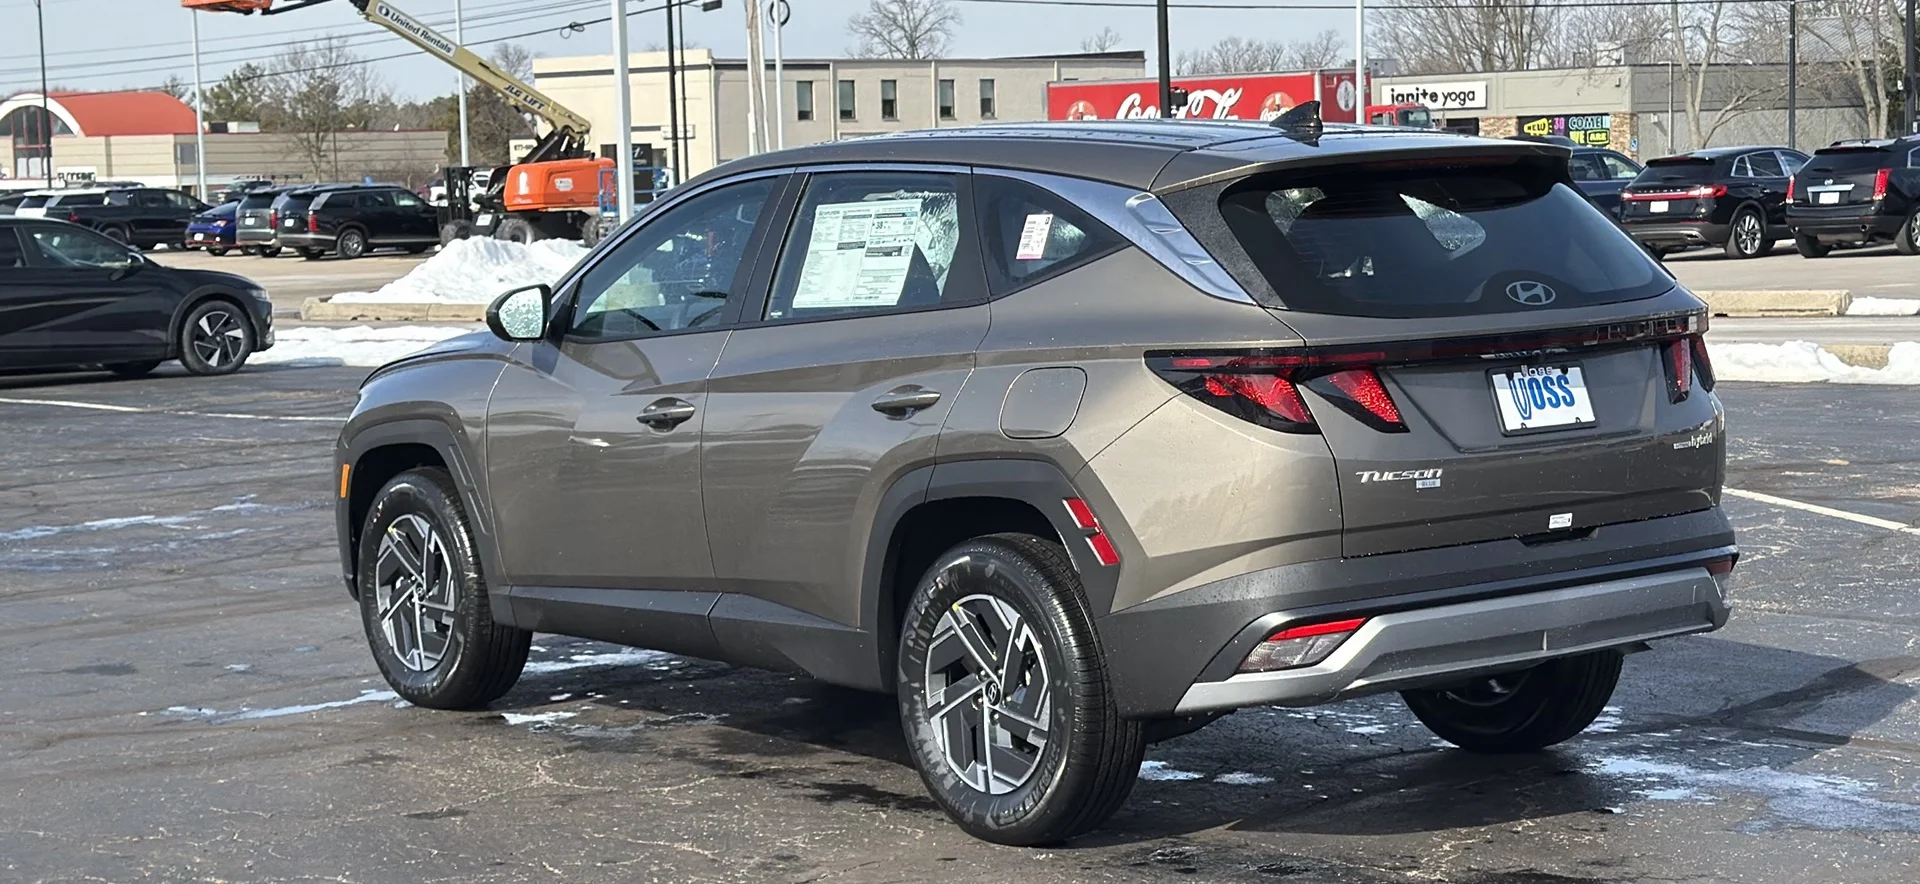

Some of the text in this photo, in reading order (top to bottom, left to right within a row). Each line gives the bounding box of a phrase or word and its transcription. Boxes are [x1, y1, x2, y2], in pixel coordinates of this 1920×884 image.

[389, 12, 452, 54] United Rentals
[504, 84, 545, 110] JLG LIFT
[1441, 90, 1475, 107] yoga
[1527, 122, 1546, 131] NEW
[1553, 117, 1565, 130] 30
[1568, 115, 1601, 130] COME
[1508, 374, 1575, 420] VOSS
[1691, 432, 1713, 449] hybrid
